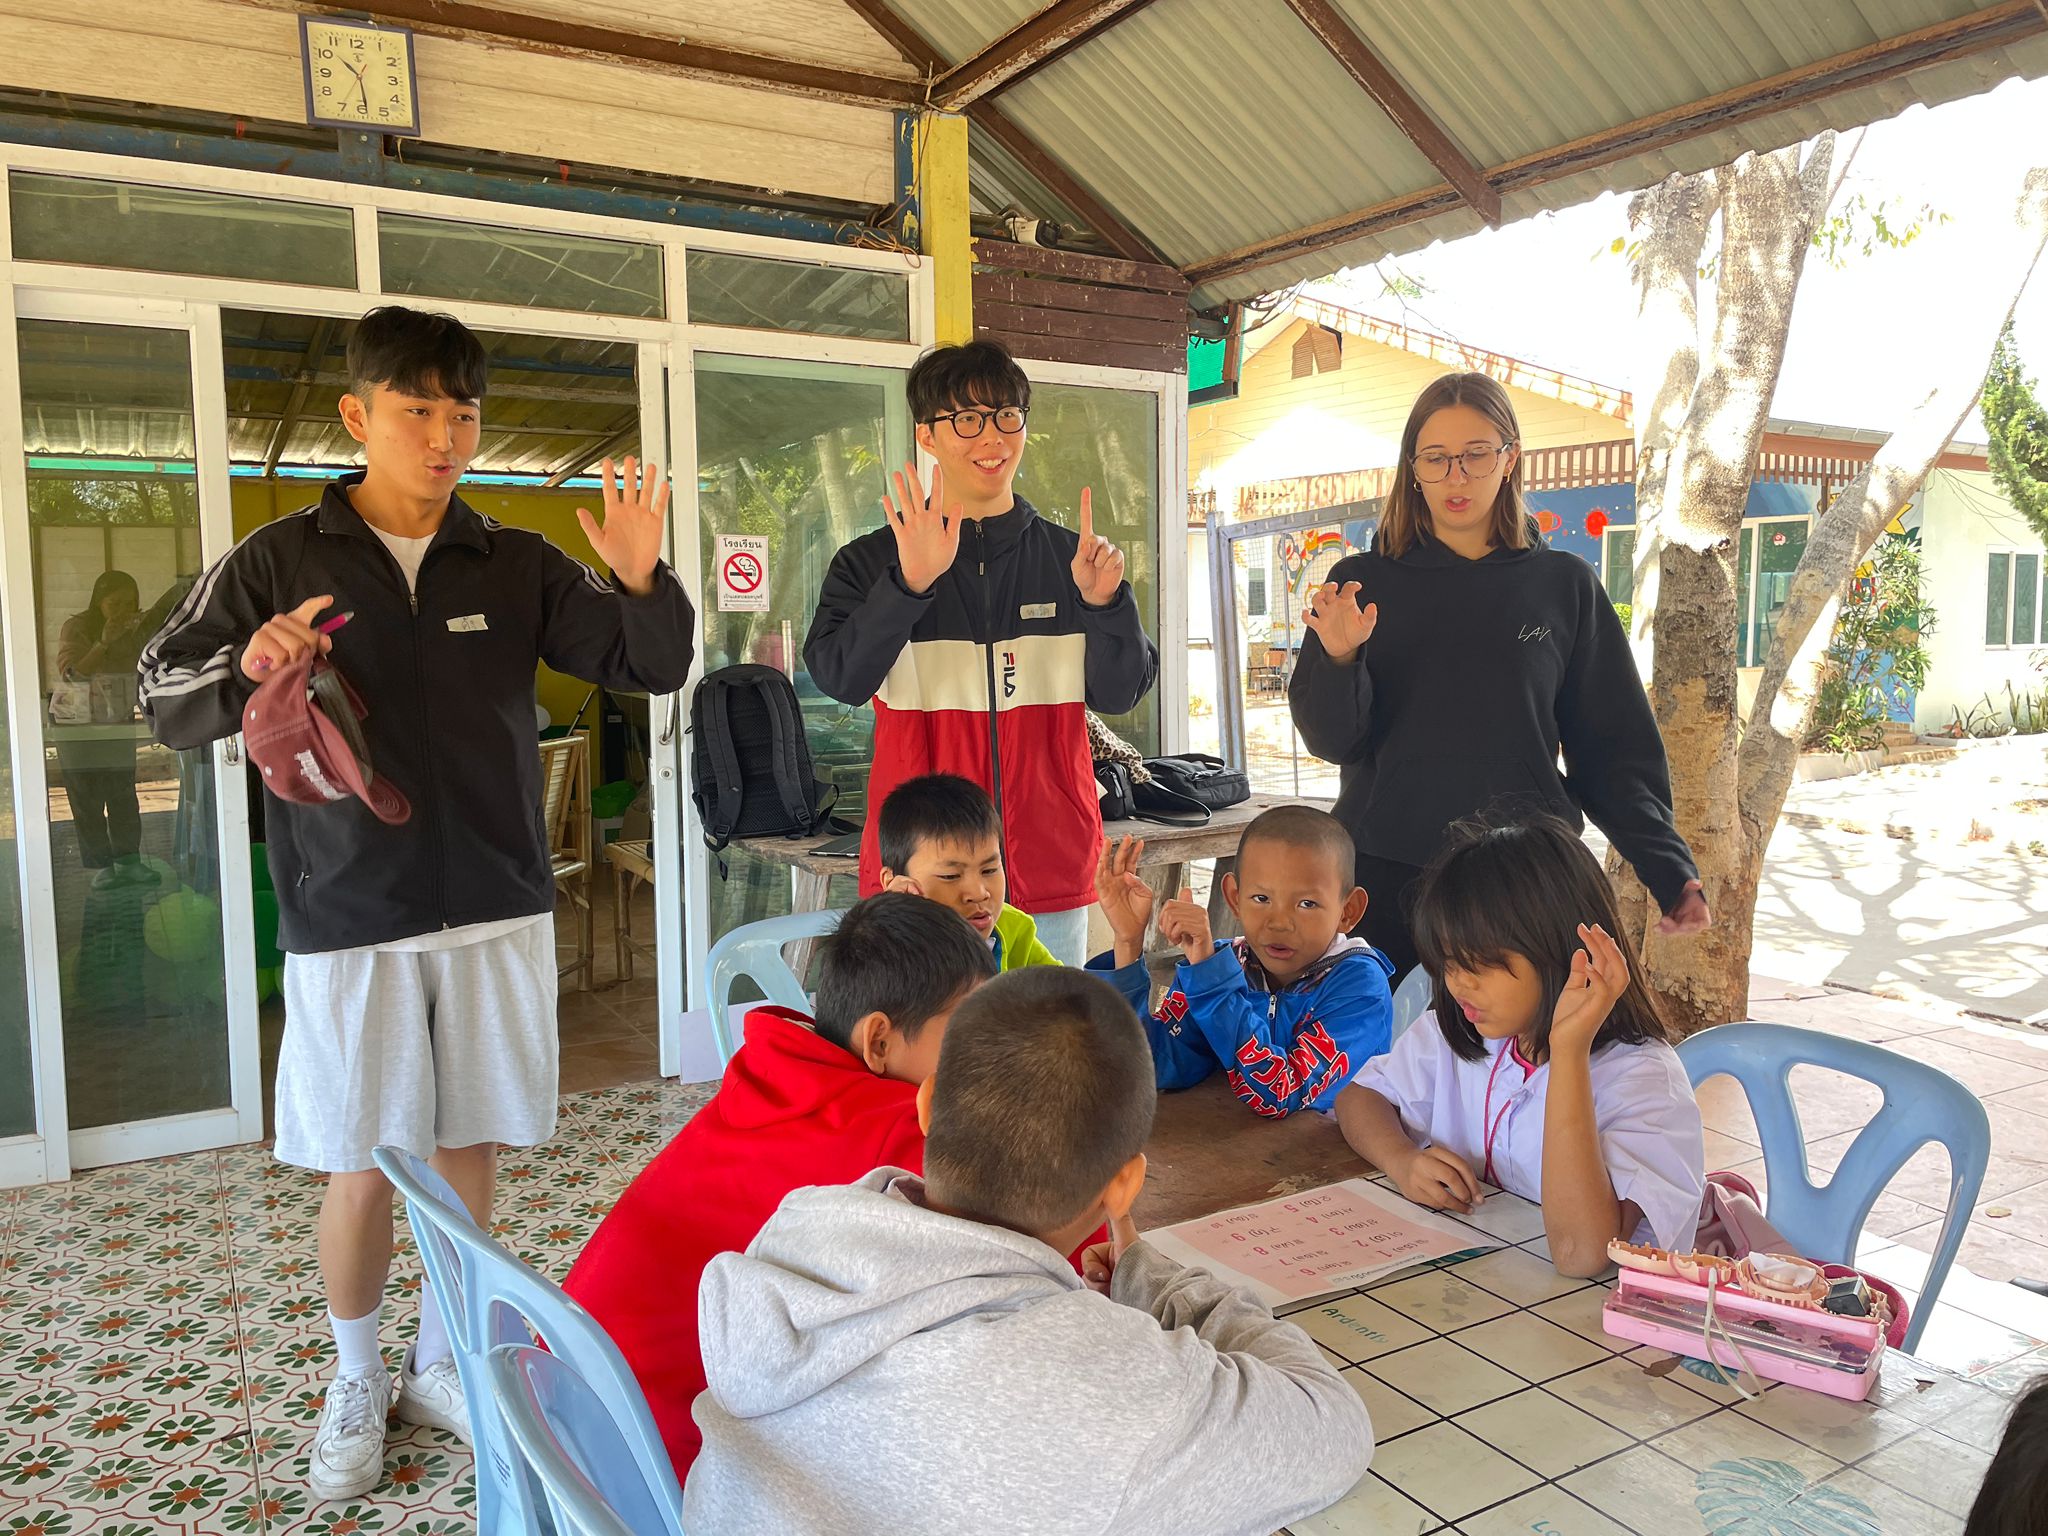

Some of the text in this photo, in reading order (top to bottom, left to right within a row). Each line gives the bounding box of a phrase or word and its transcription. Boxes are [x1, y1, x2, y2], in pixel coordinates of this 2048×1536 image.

[329, 35, 338, 47] 11
[349, 38, 365, 50] 12
[318, 48, 333, 59] 10
[386, 57, 397, 67] 2
[320, 68, 332, 78] 9
[387, 76, 398, 86] 3
[322, 86, 332, 96] 8
[390, 94, 400, 104] 4
[337, 102, 347, 112] 7
[356, 104, 368, 114] 6
[378, 107, 389, 117] 5
[723, 537, 762, 548] โรงเรียน
[1003, 652, 1016, 698] FILA
[1283, 1203, 1299, 1213] 5
[1306, 1216, 1319, 1224] 4
[1329, 1227, 1345, 1236] 3
[1231, 1233, 1246, 1242] 9
[1352, 1240, 1369, 1248] 2
[1253, 1246, 1269, 1255] 8
[1299, 1268, 1316, 1276] 6
